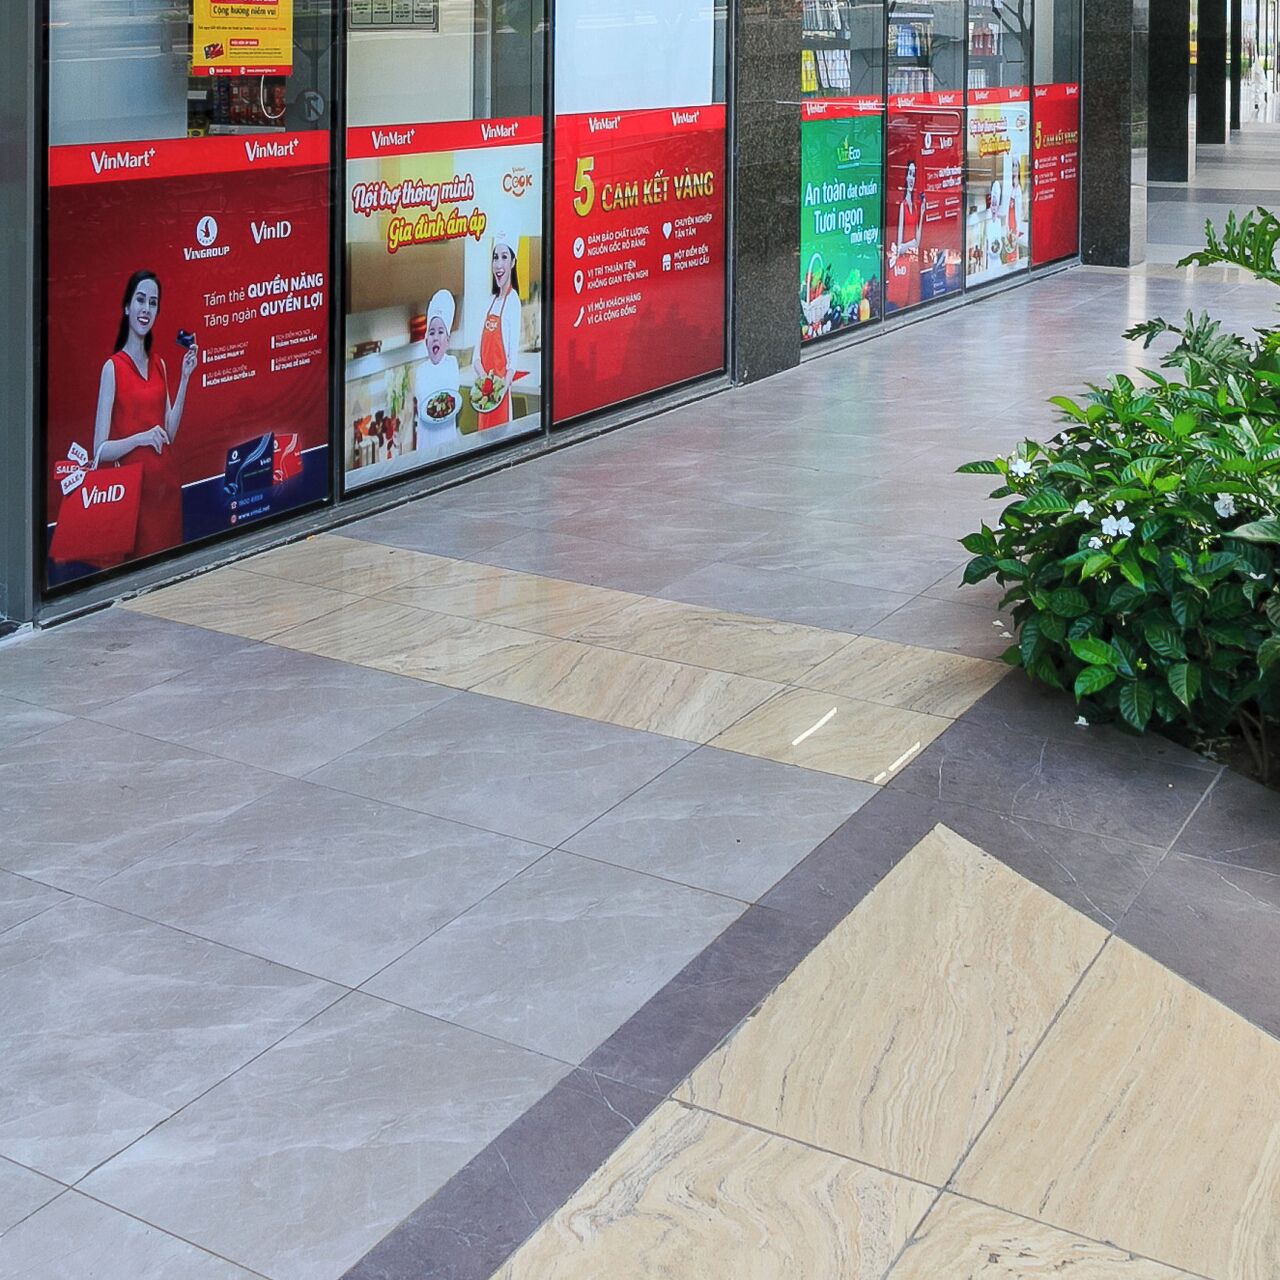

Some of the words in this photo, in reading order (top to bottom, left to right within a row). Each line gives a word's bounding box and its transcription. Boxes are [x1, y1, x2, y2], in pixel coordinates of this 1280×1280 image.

[354, 184, 377, 214] Nội
[380, 183, 401, 212] trợ
[402, 179, 439, 209] thông
[441, 174, 473, 200] minh
[573, 156, 595, 217] 5
[601, 182, 638, 212] CAM
[643, 170, 669, 204] KẾT
[674, 168, 714, 200] VÀNG
[805, 183, 820, 206] An
[823, 178, 845, 201] toàn
[251, 221, 291, 244] VinID
[389, 218, 412, 252] Gia
[415, 213, 445, 238] đình
[447, 210, 467, 234] ấm
[470, 210, 486, 240] áp
[814, 208, 836, 234] Tươi
[839, 207, 863, 235] ngon
[204, 292, 225, 306] Tấm
[229, 287, 245, 303] thẻ
[248, 274, 288, 298] QUYỀN
[291, 272, 323, 291] NĂNG
[260, 292, 301, 316] QUYỀN
[304, 292, 322, 310] LỢI
[82, 485, 125, 509] VinID
